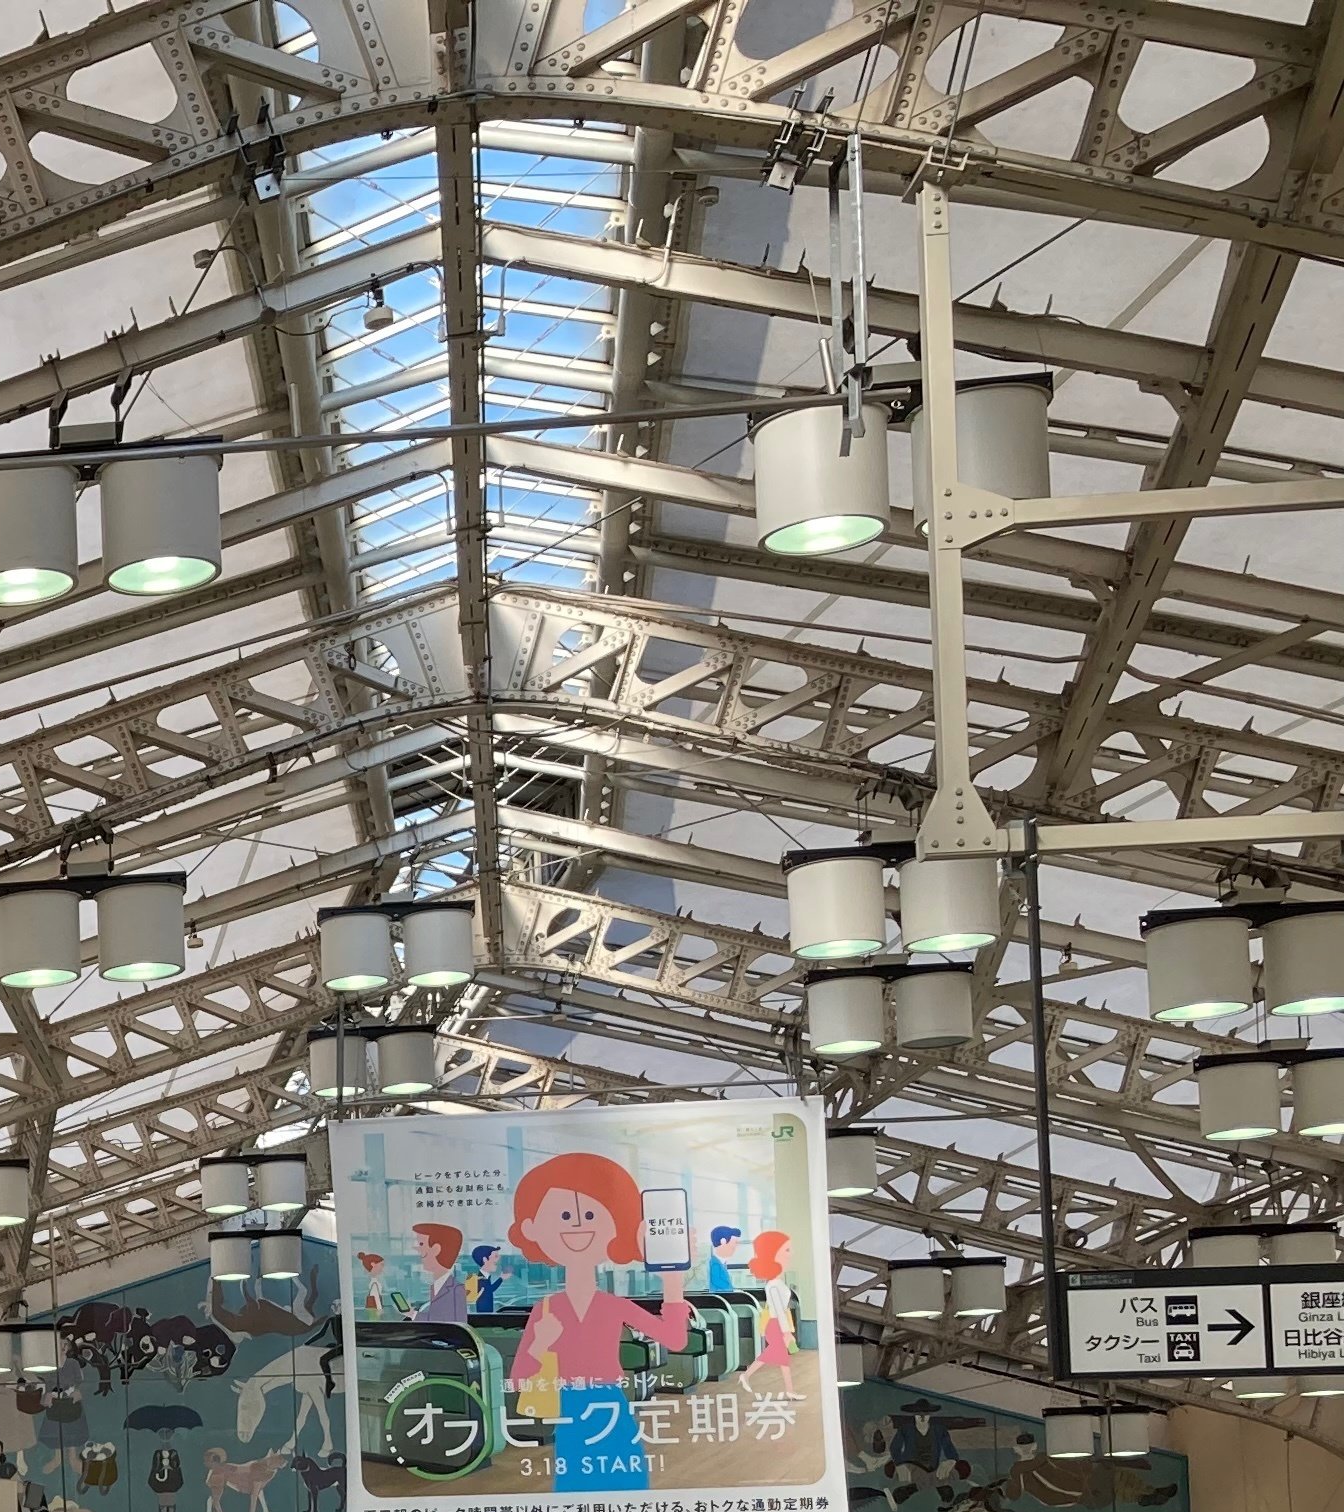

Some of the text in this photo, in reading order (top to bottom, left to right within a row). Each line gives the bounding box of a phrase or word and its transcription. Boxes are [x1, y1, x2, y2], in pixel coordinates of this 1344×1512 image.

[771, 1125, 794, 1138] JR
[648, 1217, 684, 1227] モバイル
[649, 1226, 685, 1236] Suica
[1119, 1296, 1158, 1314] バス
[1300, 1291, 1344, 1310] 銀座
[1136, 1316, 1159, 1327] Bus
[1298, 1311, 1334, 1322] Ginza
[1085, 1334, 1160, 1352] タクシー
[1169, 1332, 1197, 1342] TAXI
[1284, 1327, 1344, 1347] 日比谷
[1137, 1353, 1161, 1364] Taxi
[1298, 1348, 1336, 1361] Hibiya
[500, 1374, 685, 1393] 通勤を快適に、おトクに。
[403, 1391, 796, 1457] オフピーク定期券
[520, 1454, 665, 1476] 3.18 START!
